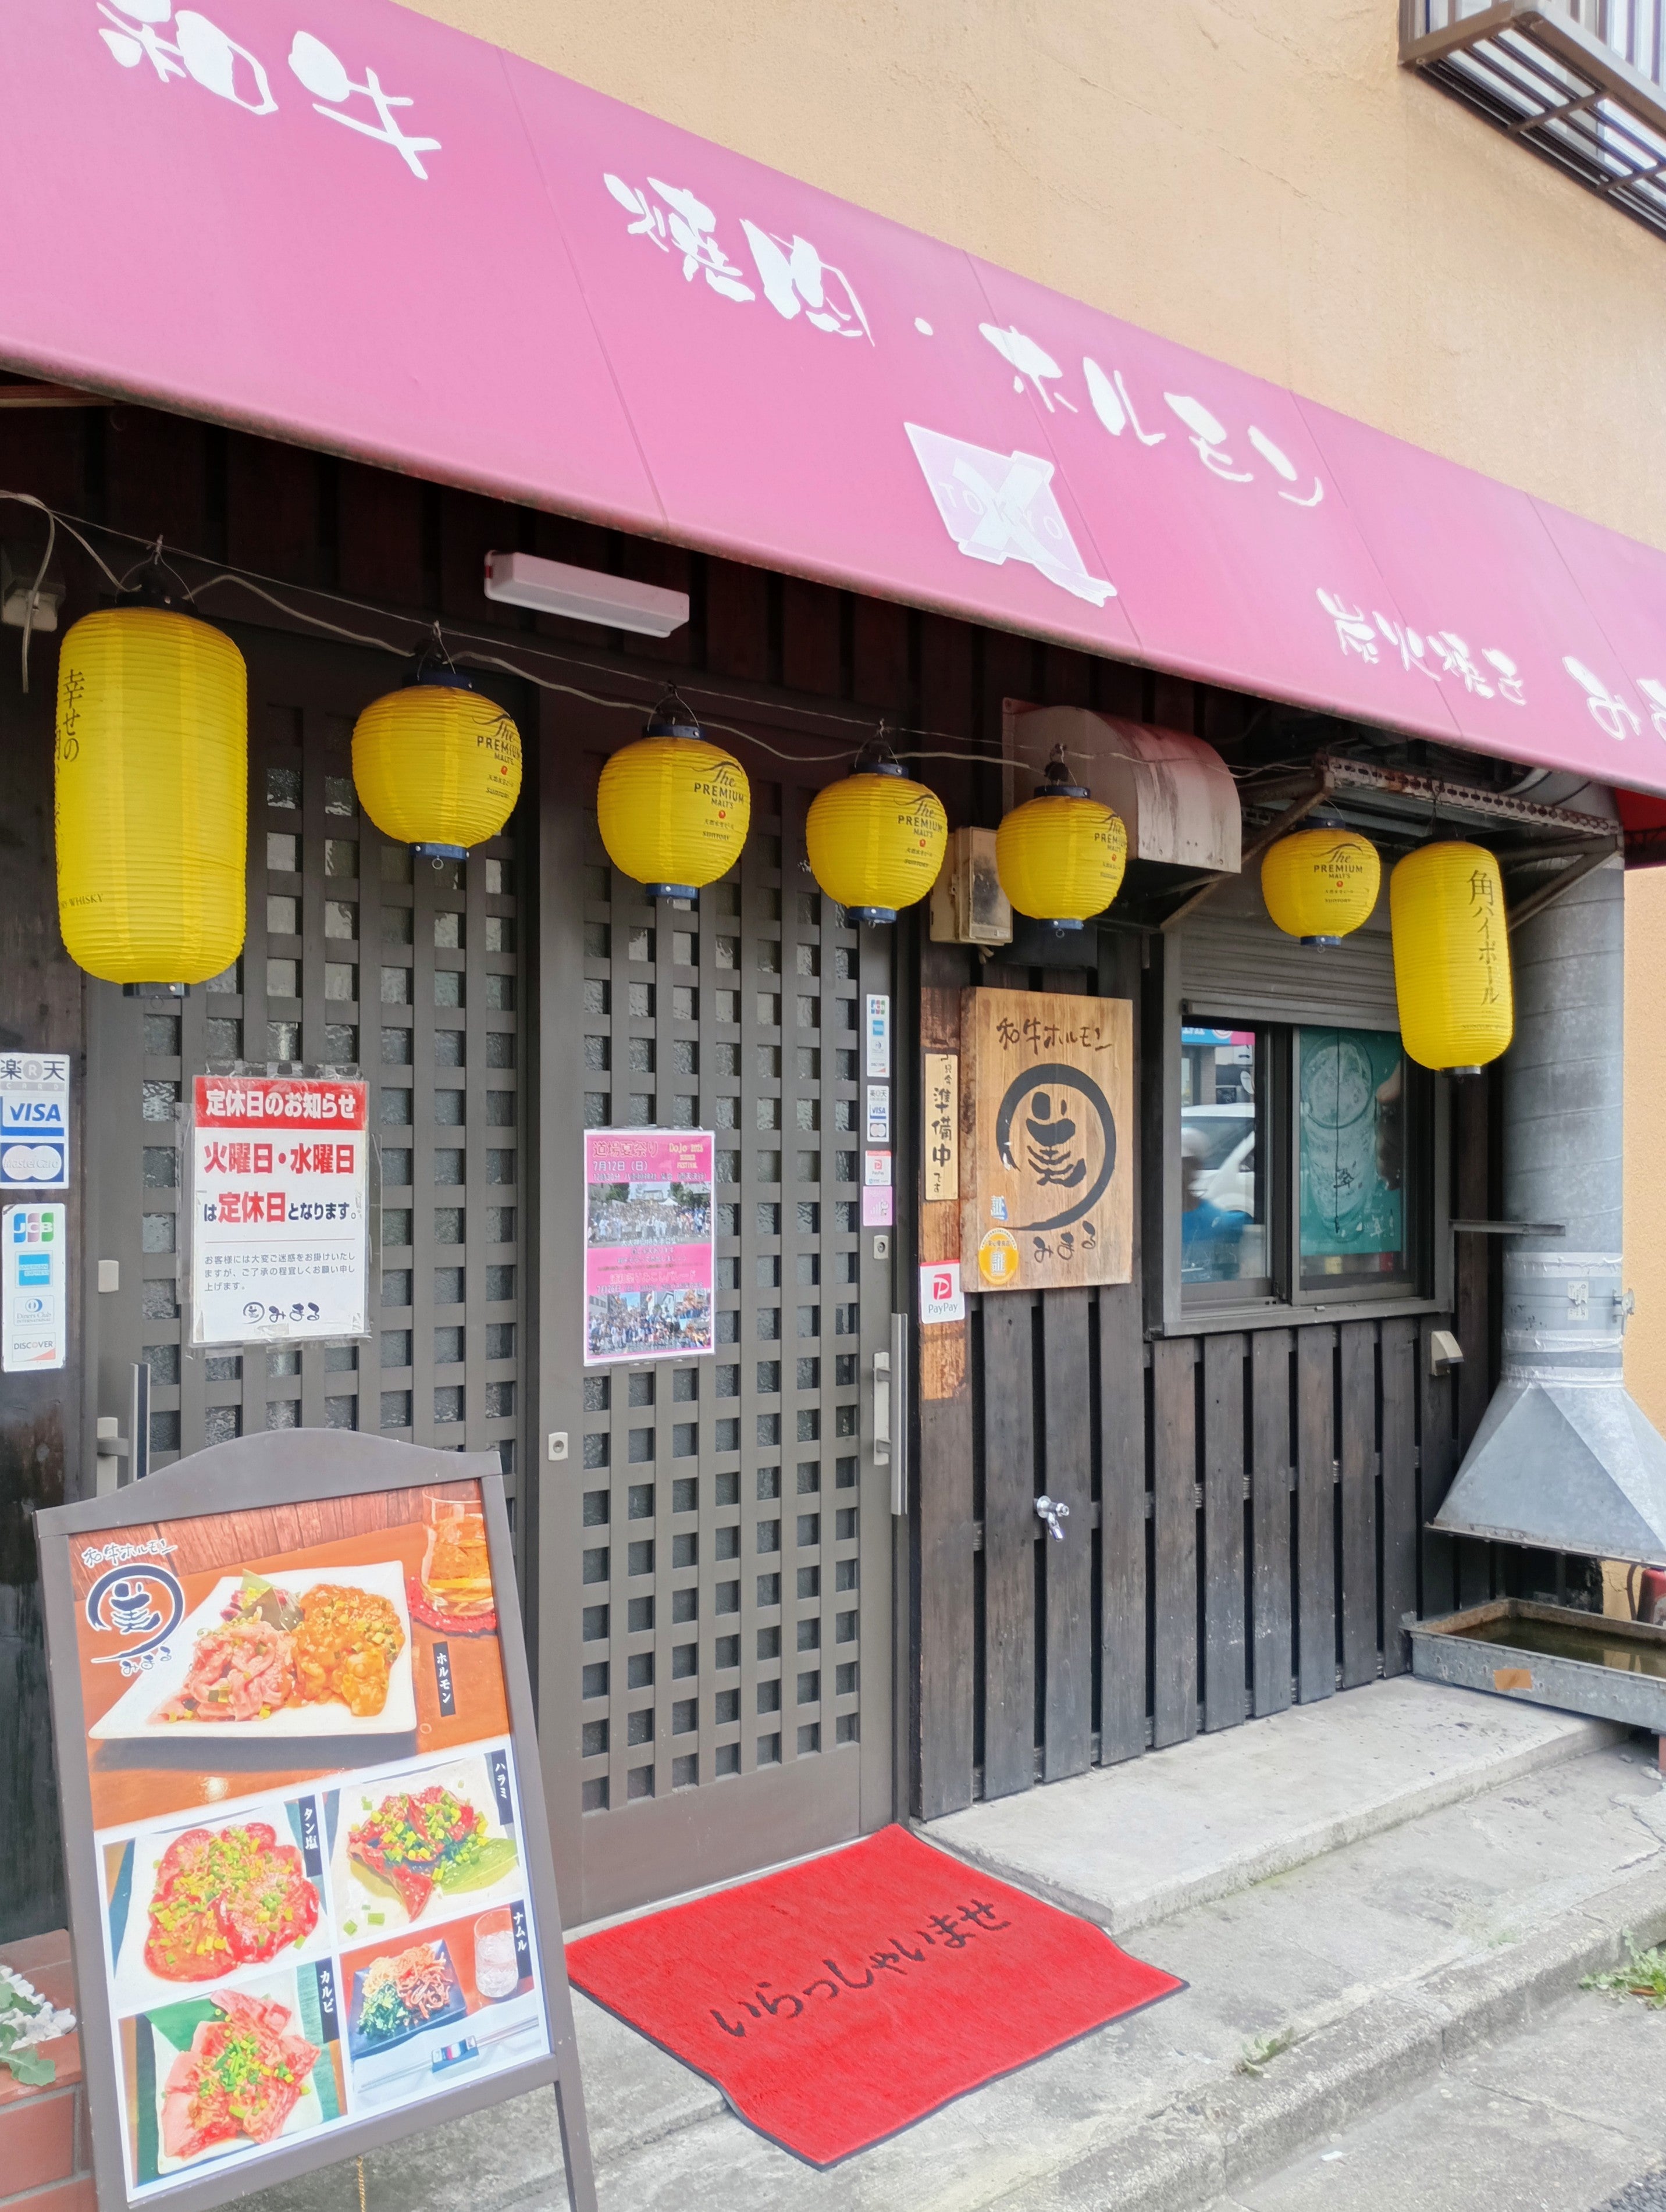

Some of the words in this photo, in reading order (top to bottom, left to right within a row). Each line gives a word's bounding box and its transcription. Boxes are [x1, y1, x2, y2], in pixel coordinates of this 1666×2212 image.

[63, 669, 85, 763] 幸せの
[694, 782, 744, 804] PREMIUM
[898, 815, 943, 833] PREMIUM
[1313, 864, 1363, 874] PREMIUM
[69, 893, 104, 907] WHISKY
[1466, 869, 1500, 1007] 角ハイボール
[996, 1016, 1113, 1056] 和牛ホルモン
[10, 1103, 61, 1121] VISA
[205, 1089, 357, 1120] 定休日のお知らせ
[204, 1141, 355, 1175] 火曜日・水曜日
[593, 1161, 625, 1171] 7月12日
[204, 1191, 357, 1224] は定休日となります。
[1033, 1220, 1097, 1263] みまる
[204, 1251, 355, 1265] お客様には大変ご迷惑をお掛けいたし
[204, 1264, 355, 1279] ますが、ご了承の程宜しくお願い申し
[204, 1281, 245, 1292] 上げます。
[268, 1302, 321, 1323] みまる
[928, 1302, 959, 1315] PayPay
[13, 1341, 54, 1350] DISCOVER
[82, 1538, 178, 1567] 和牛ホルモン
[120, 1645, 172, 1676] みまる
[436, 1652, 451, 1704] ホルモン
[494, 1762, 508, 1799] ハラミ
[304, 1807, 318, 1850] タン塩
[512, 1911, 528, 1953] ナムル
[709, 1898, 1012, 2038] いらっしゃいませ
[319, 1970, 334, 2013] カルビ
